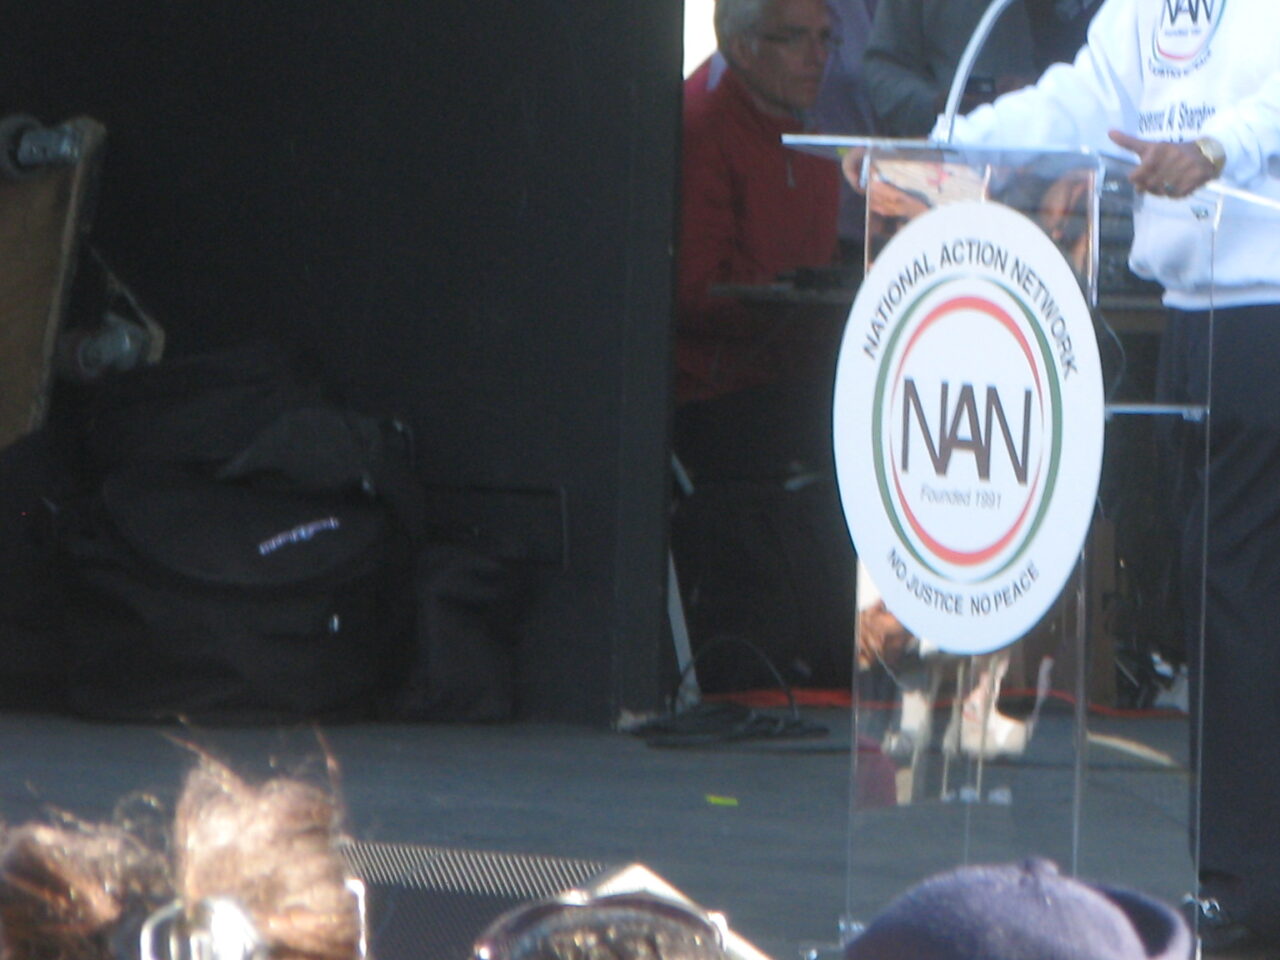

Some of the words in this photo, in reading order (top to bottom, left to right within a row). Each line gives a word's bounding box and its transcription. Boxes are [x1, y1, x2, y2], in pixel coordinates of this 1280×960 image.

[862, 251, 935, 361] NATIONAL
[939, 239, 1009, 275] ACTION
[1010, 258, 1079, 381] NETWORK
[900, 375, 1033, 486] NAN
[919, 482, 971, 507] Founded
[975, 490, 1003, 510] 1991
[886, 547, 908, 582] NO
[906, 576, 964, 616] JUSTICE
[970, 593, 992, 617] NO
[993, 558, 1041, 613] PEACE
